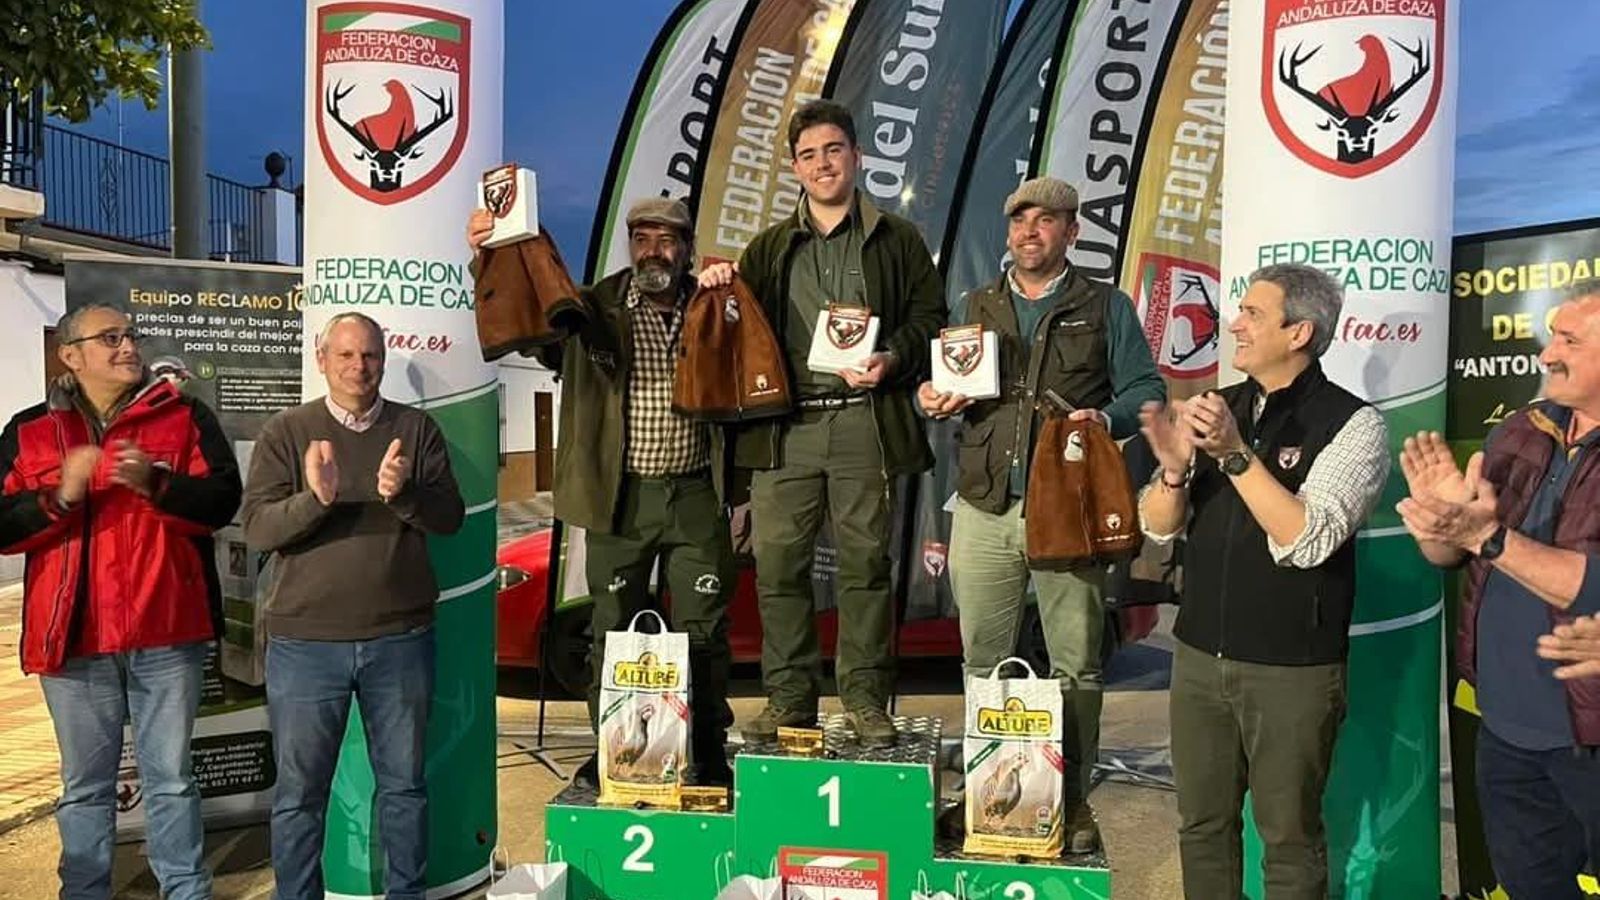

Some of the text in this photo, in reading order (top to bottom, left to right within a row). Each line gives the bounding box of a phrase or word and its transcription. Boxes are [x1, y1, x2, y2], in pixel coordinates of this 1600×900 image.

[1277, 1, 1368, 28] ANDALUZA
[1400, 2, 1436, 17] CAZA
[341, 32, 436, 52] FEDERACION
[324, 47, 460, 72] ANDALUZA DE CAZA
[661, 35, 728, 204] PORT
[716, 47, 795, 250] FEDERACIÓN
[865, 101, 919, 198] del
[1068, 0, 1150, 284] UASPOR
[1257, 238, 1433, 271] FEDERACION
[315, 258, 463, 285] FEDERACION
[1369, 268, 1407, 290] DE
[130, 288, 192, 307] Equipo
[197, 292, 282, 310] RECLAMO
[303, 284, 394, 306] NDALUZA
[400, 285, 434, 307] DE
[136, 312, 185, 324] precias
[187, 313, 205, 324] de
[208, 315, 226, 325] ser
[230, 316, 245, 327] un
[248, 316, 280, 328] buen
[1493, 312, 1536, 341] DE
[175, 327, 236, 339] prescindir
[238, 328, 257, 340] del
[260, 330, 294, 343] mejor
[184, 341, 214, 352] para
[216, 340, 229, 352] la
[230, 342, 261, 353] caza
[263, 344, 287, 354] con
[982, 716, 1049, 733] ALTUBE
[817, 775, 841, 827] 1
[622, 824, 655, 873] 2
